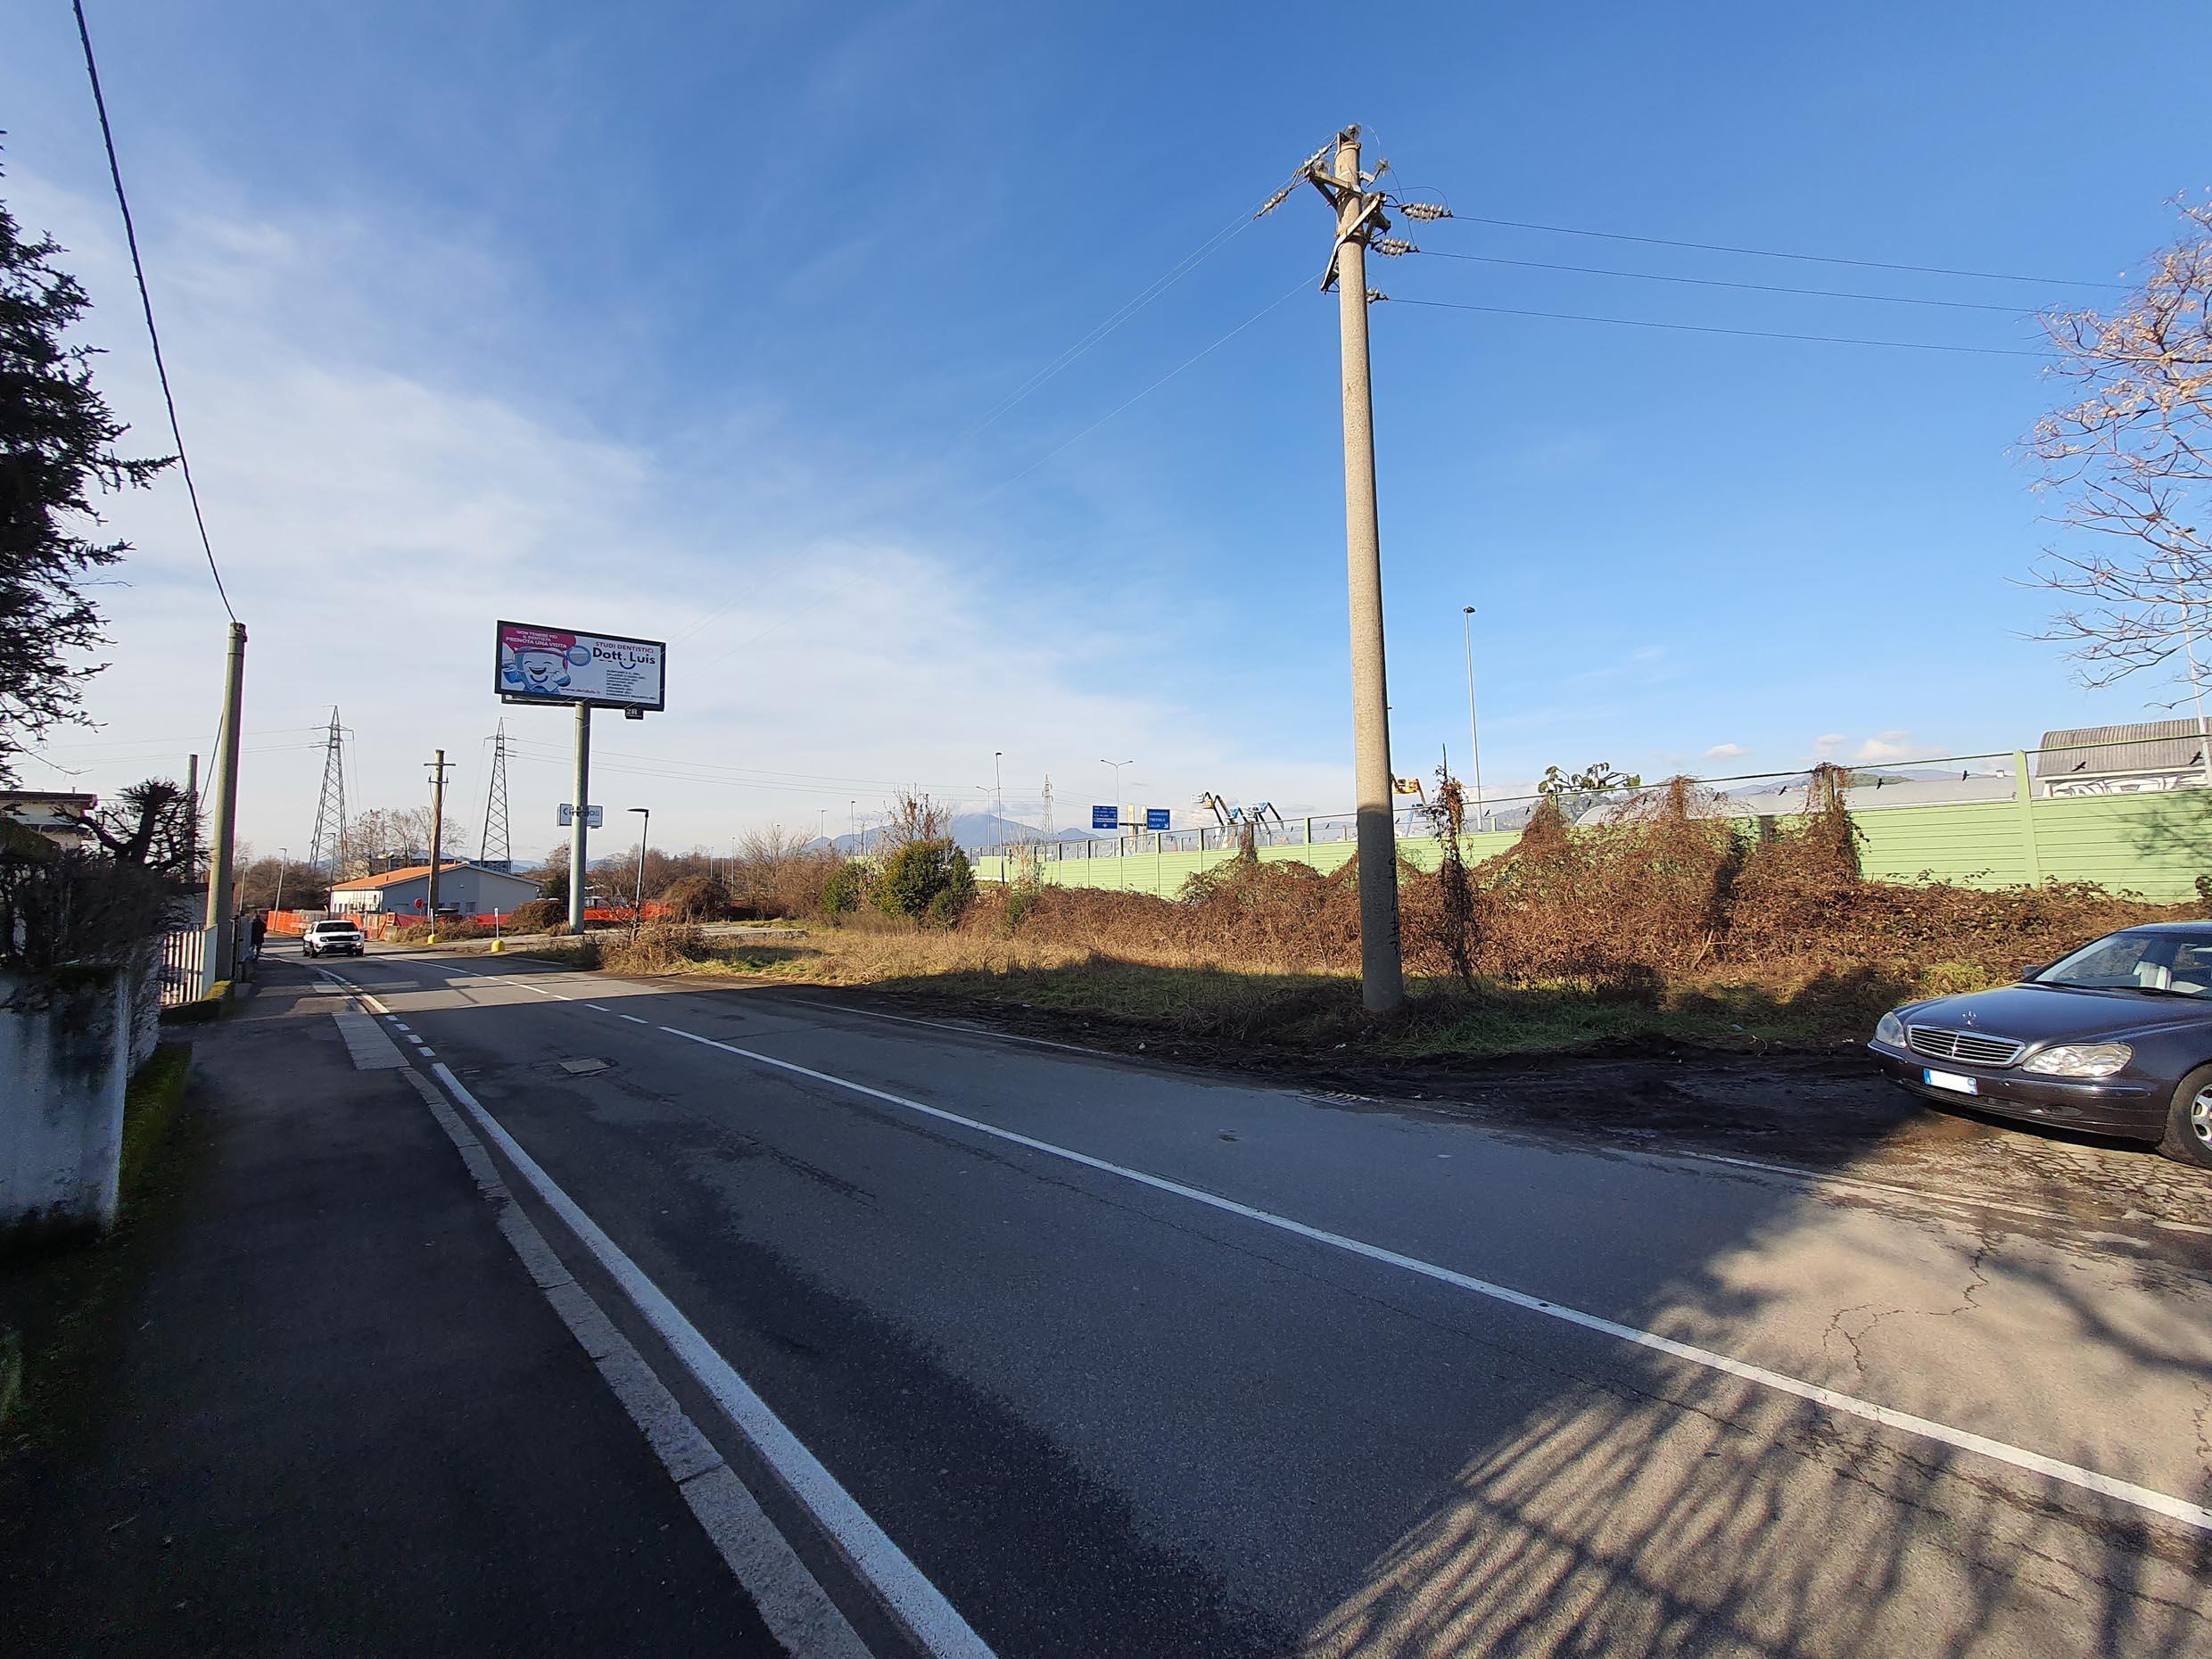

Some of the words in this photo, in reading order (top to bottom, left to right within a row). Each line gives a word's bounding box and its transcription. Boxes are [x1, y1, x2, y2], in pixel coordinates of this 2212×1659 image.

[506, 636, 534, 644] PRENOTA
[595, 641, 616, 649] STUDI
[617, 644, 654, 654] DENTISTICI
[592, 647, 627, 661] Dott.
[630, 651, 656, 664] Luis
